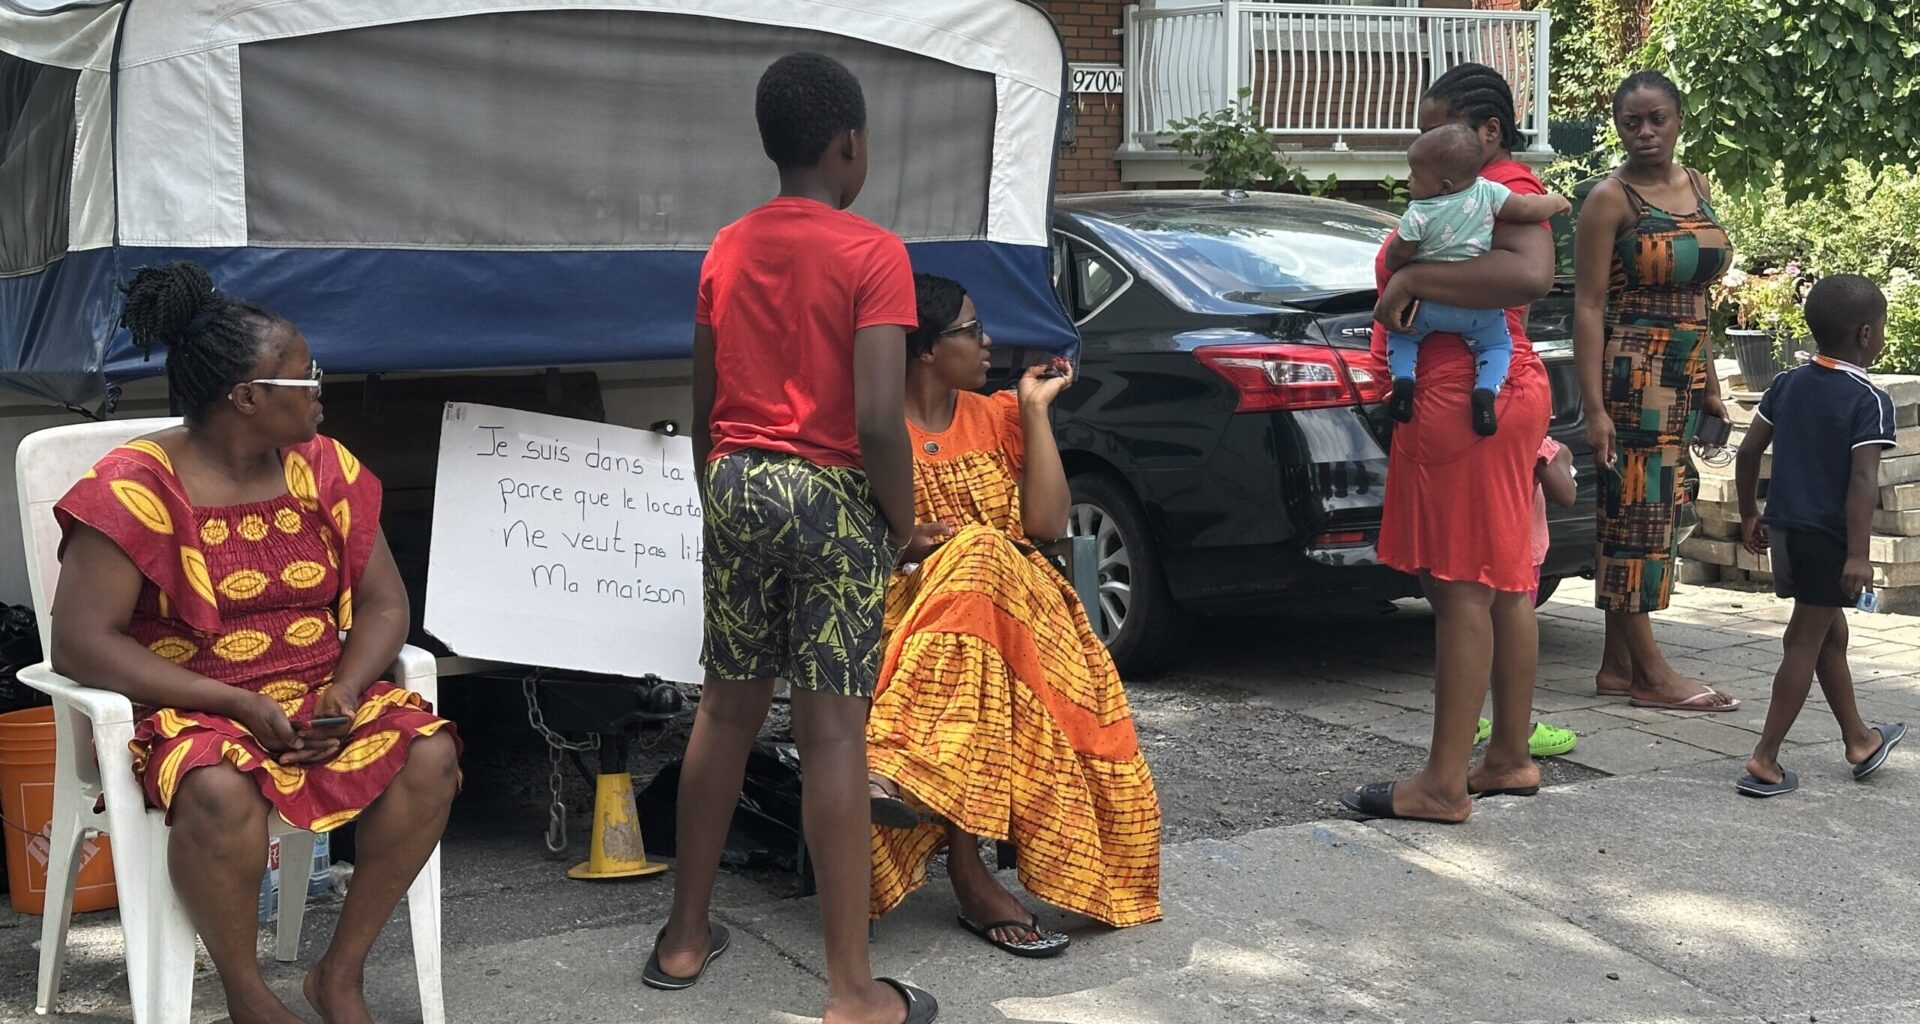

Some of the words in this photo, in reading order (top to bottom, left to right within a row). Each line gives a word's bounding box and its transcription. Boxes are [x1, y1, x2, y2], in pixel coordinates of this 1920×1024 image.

[477, 426, 508, 458] Je
[521, 439, 570, 462] suis
[585, 438, 644, 475] dans
[662, 448, 684, 481] la
[574, 490, 610, 521] que
[623, 488, 637, 510] le
[562, 521, 626, 553] veut
[634, 542, 667, 568] pas
[597, 579, 686, 605] maison
